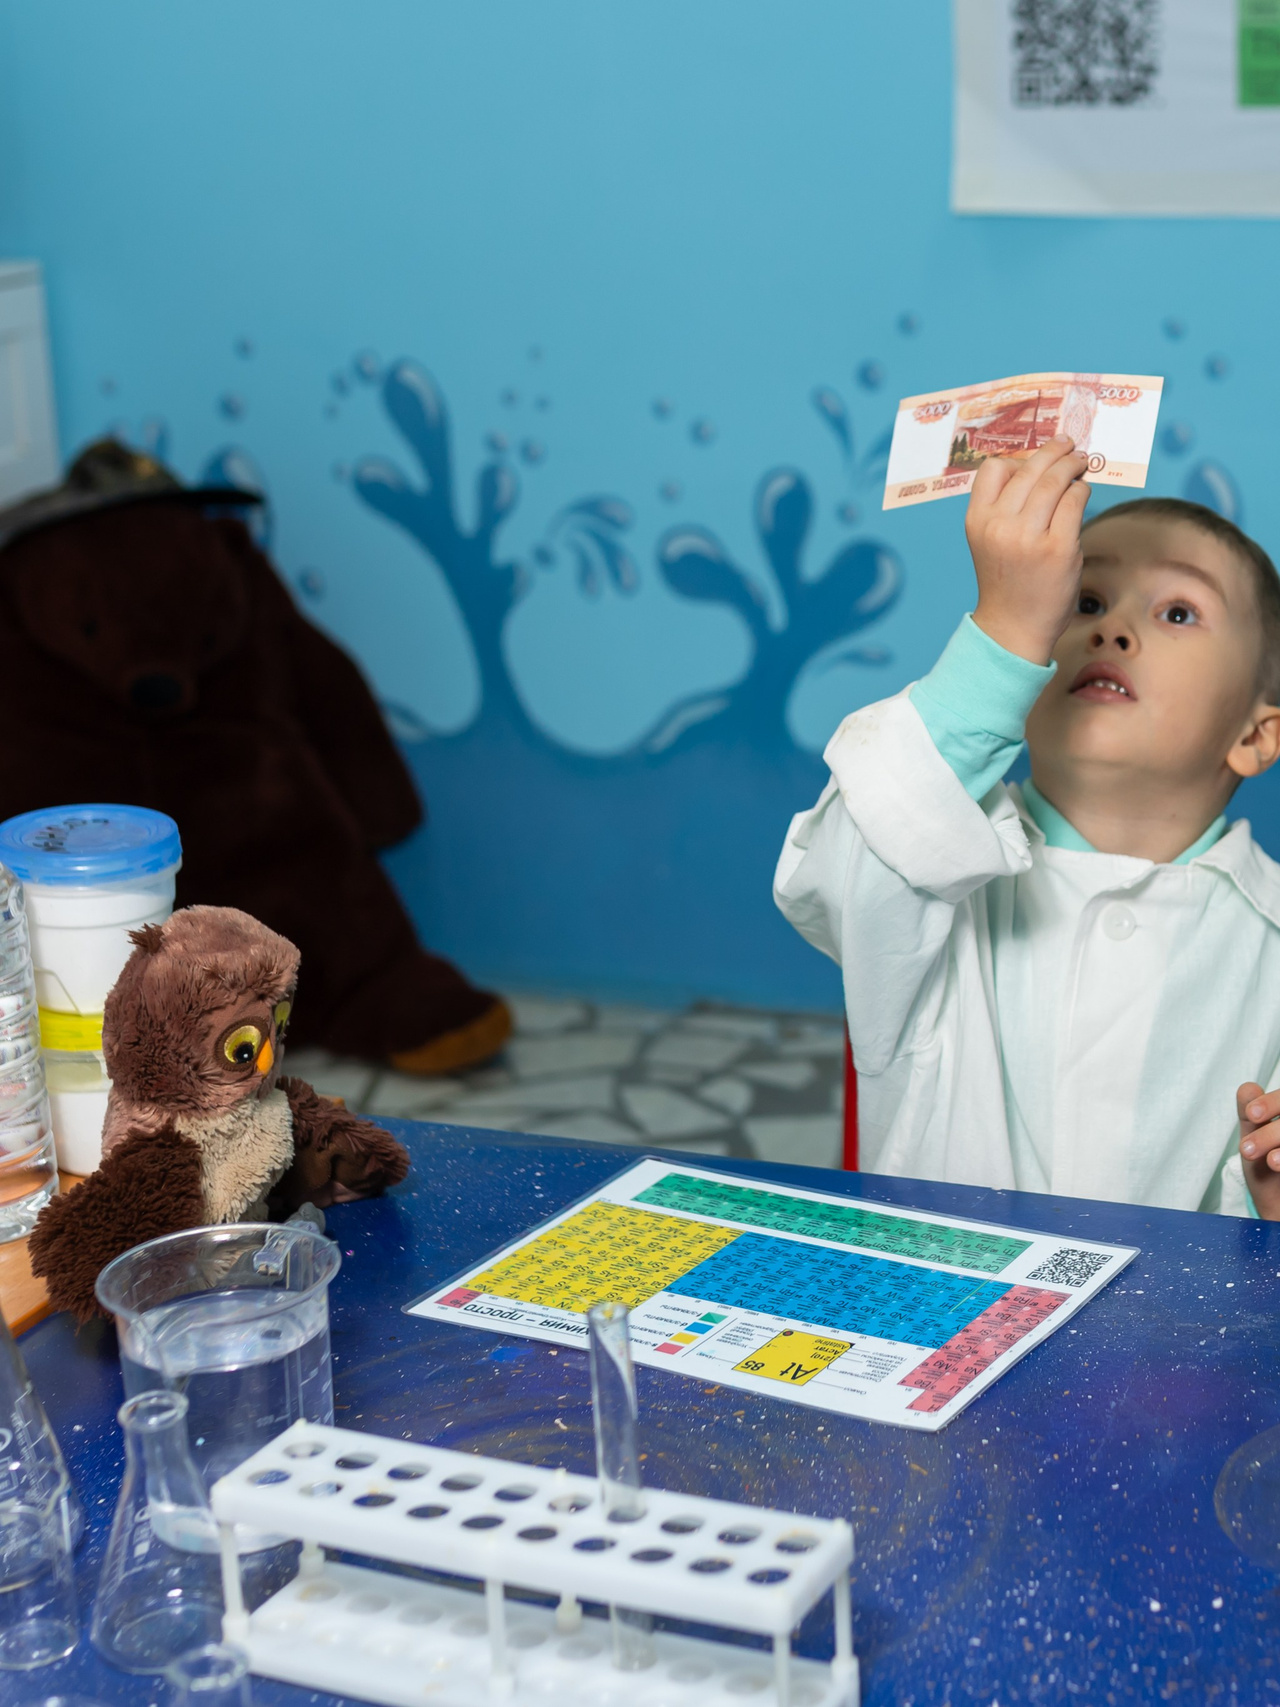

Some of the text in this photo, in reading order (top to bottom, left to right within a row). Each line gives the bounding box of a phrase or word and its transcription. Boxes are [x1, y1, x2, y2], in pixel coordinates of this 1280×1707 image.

[1099, 387, 1139, 400] 5000
[464, 1304, 524, 1321] просто
[740, 1360, 765, 1371] 85
[780, 1362, 818, 1380] At
